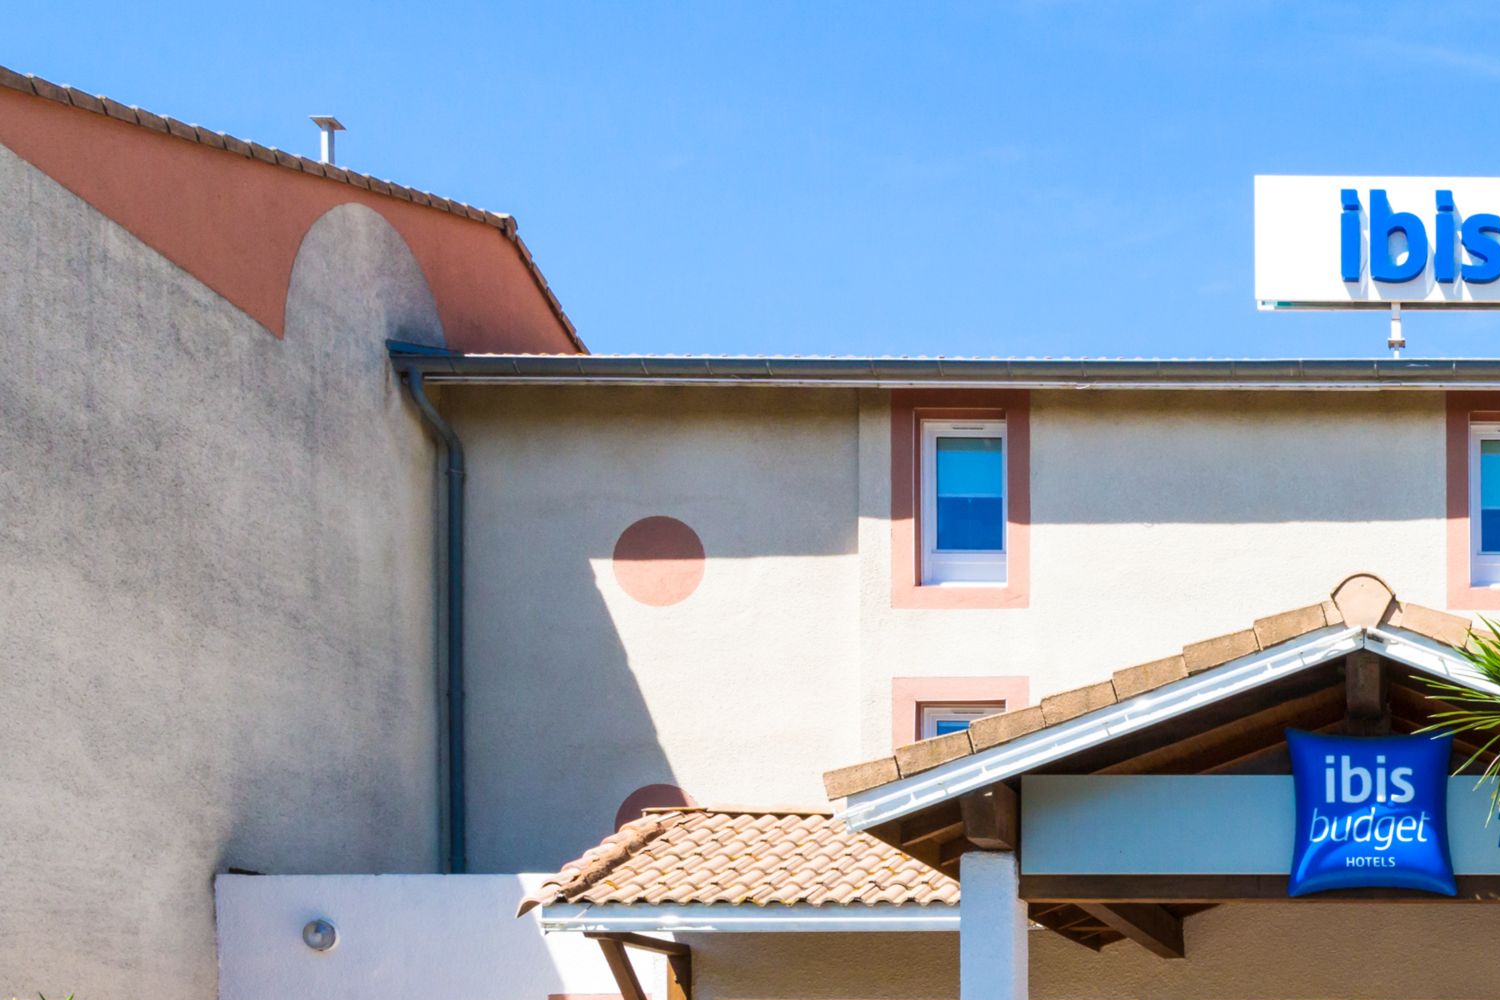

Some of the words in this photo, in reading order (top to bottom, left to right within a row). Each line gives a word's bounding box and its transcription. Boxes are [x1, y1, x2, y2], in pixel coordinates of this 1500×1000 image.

[1325, 755, 1415, 804] ibis
[1309, 806, 1431, 851] budget
[1345, 856, 1396, 868] HOTELS
